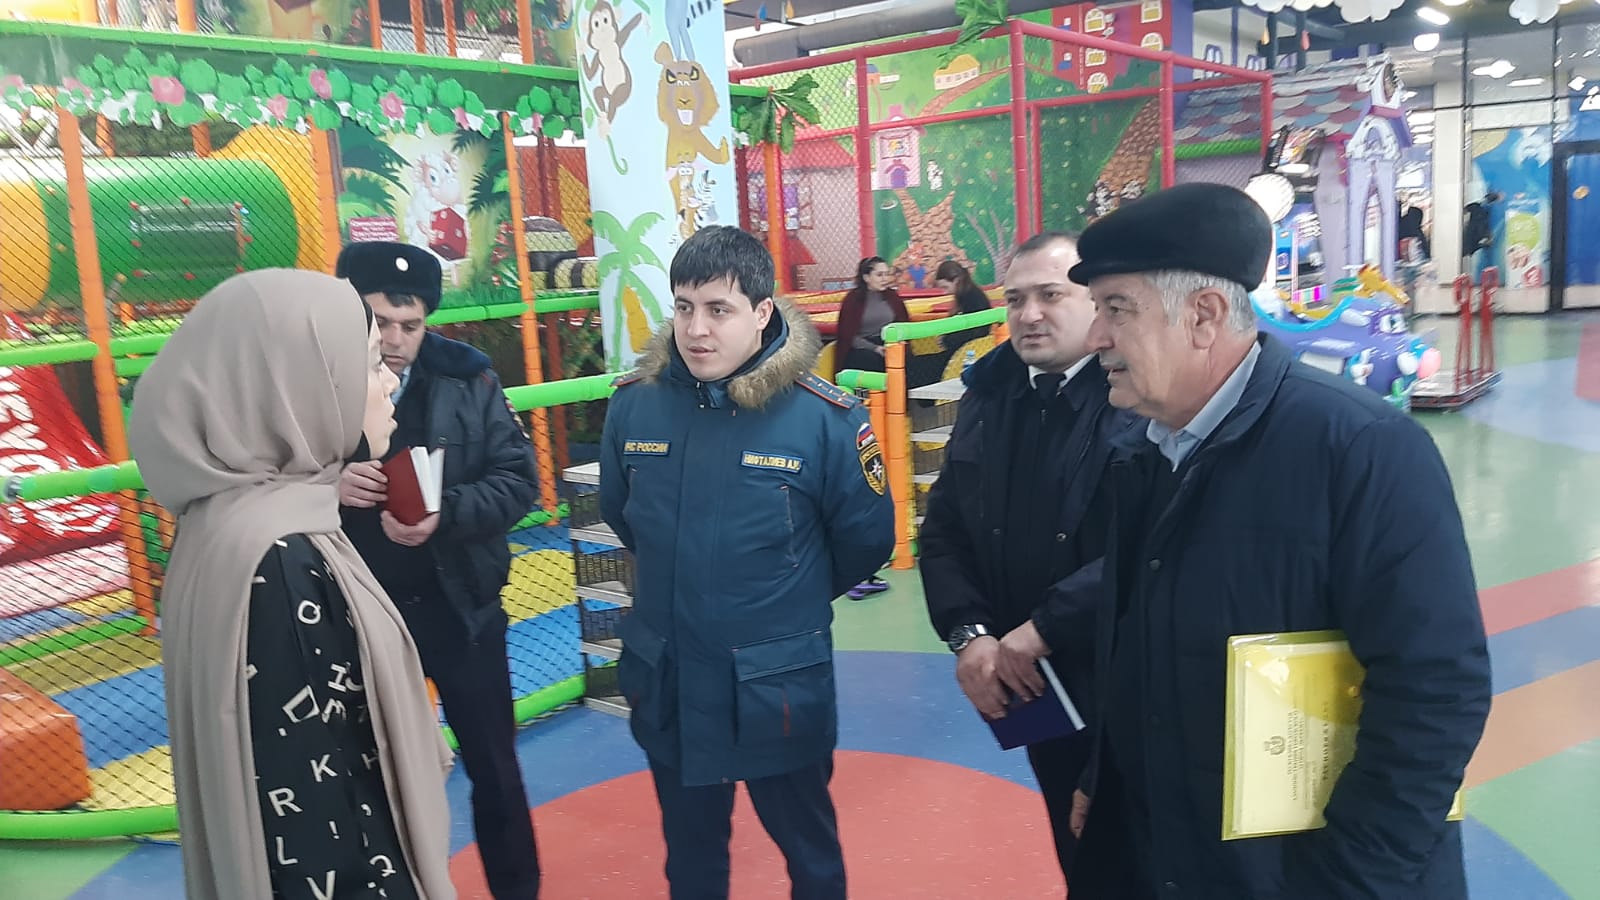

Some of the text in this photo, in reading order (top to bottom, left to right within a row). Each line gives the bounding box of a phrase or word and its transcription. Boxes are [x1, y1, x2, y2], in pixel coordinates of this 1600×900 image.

[637, 442, 669, 453] РОССИИ
[310, 754, 338, 782] K
[268, 787, 303, 817] R
[275, 836, 298, 865] L
[305, 870, 336, 900] V
